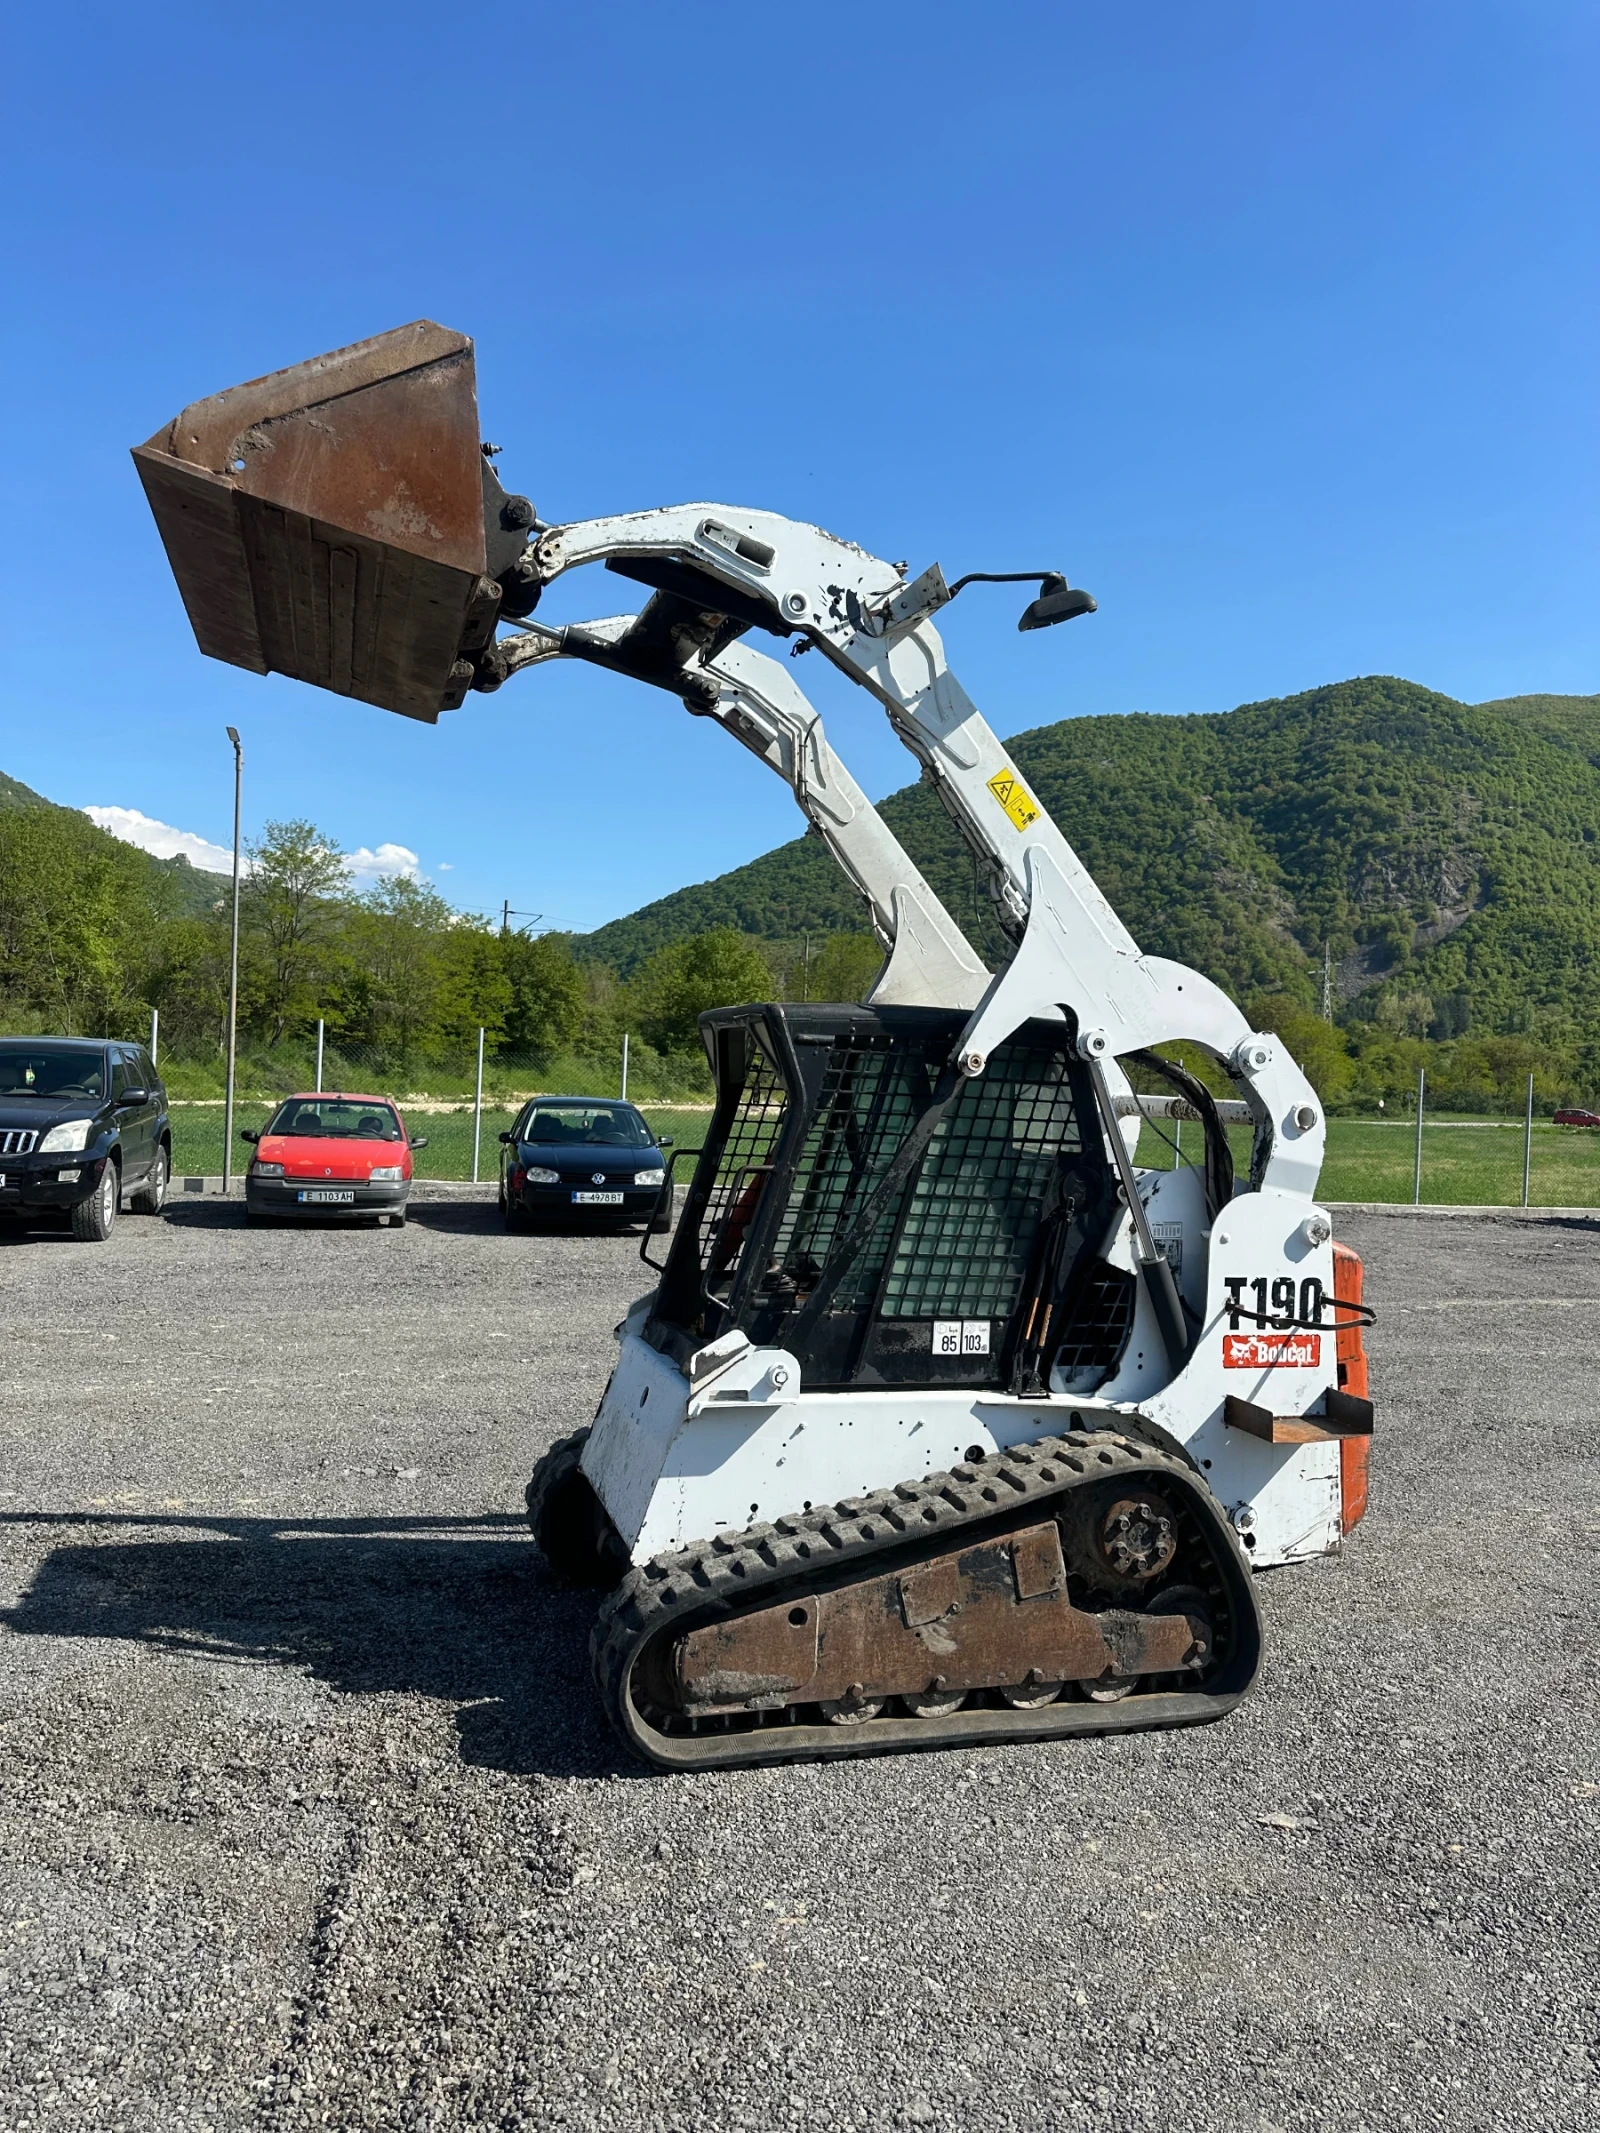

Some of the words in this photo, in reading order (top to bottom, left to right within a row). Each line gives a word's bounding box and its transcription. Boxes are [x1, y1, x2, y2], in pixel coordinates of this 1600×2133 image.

[307, 1192, 313, 1201] E
[1224, 1277, 1322, 1330] T190
[941, 1335, 957, 1352] 85
[964, 1334, 981, 1351] 103
[1258, 1342, 1314, 1363] Bobcat
